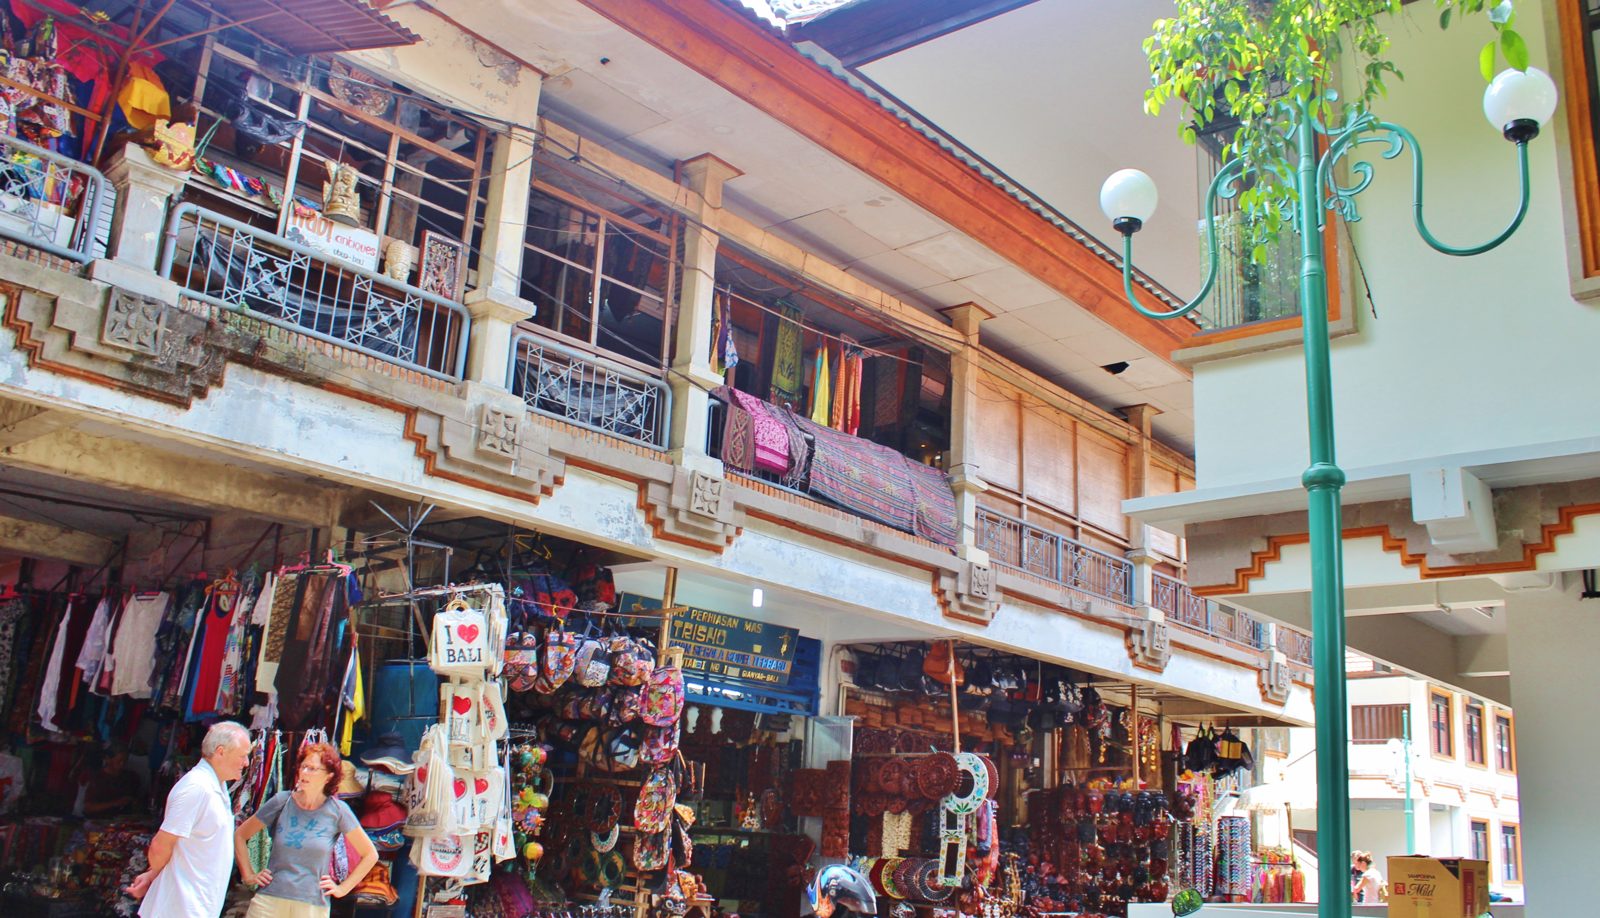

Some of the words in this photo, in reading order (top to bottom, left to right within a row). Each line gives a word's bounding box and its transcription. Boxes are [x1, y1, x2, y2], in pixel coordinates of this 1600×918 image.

[690, 608, 740, 629] PERHIASAN
[743, 620, 763, 634] MAS
[445, 625, 453, 645] I
[447, 648, 482, 663] BALI
[753, 655, 788, 672] TERBARU
[1407, 883, 1436, 897] Mild
